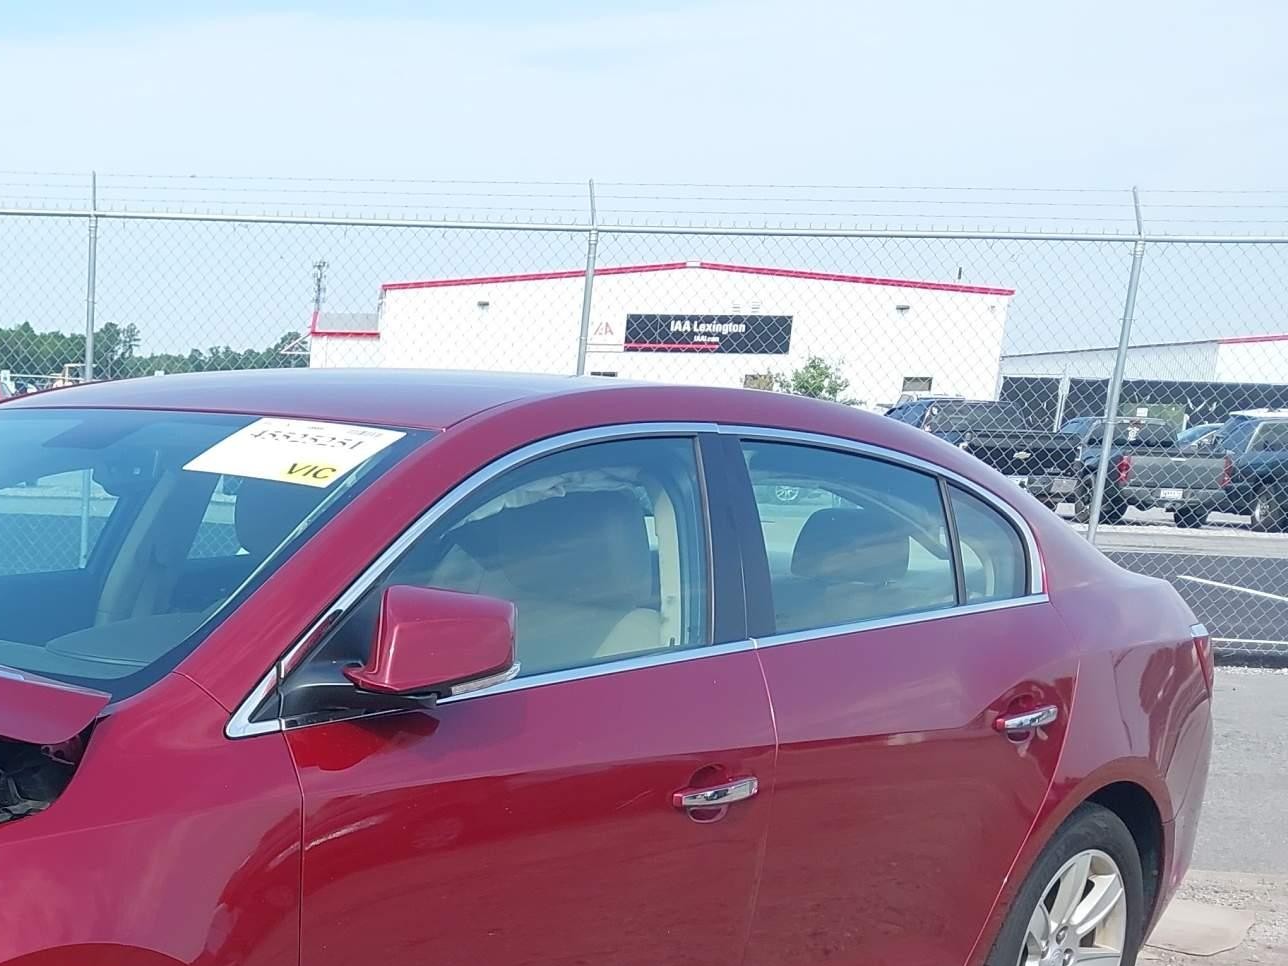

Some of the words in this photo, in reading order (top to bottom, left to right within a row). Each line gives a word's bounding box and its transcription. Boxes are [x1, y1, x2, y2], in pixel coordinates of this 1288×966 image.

[670, 320, 691, 332] IAA
[693, 320, 746, 335] Lexington
[286, 463, 337, 479] VIC
